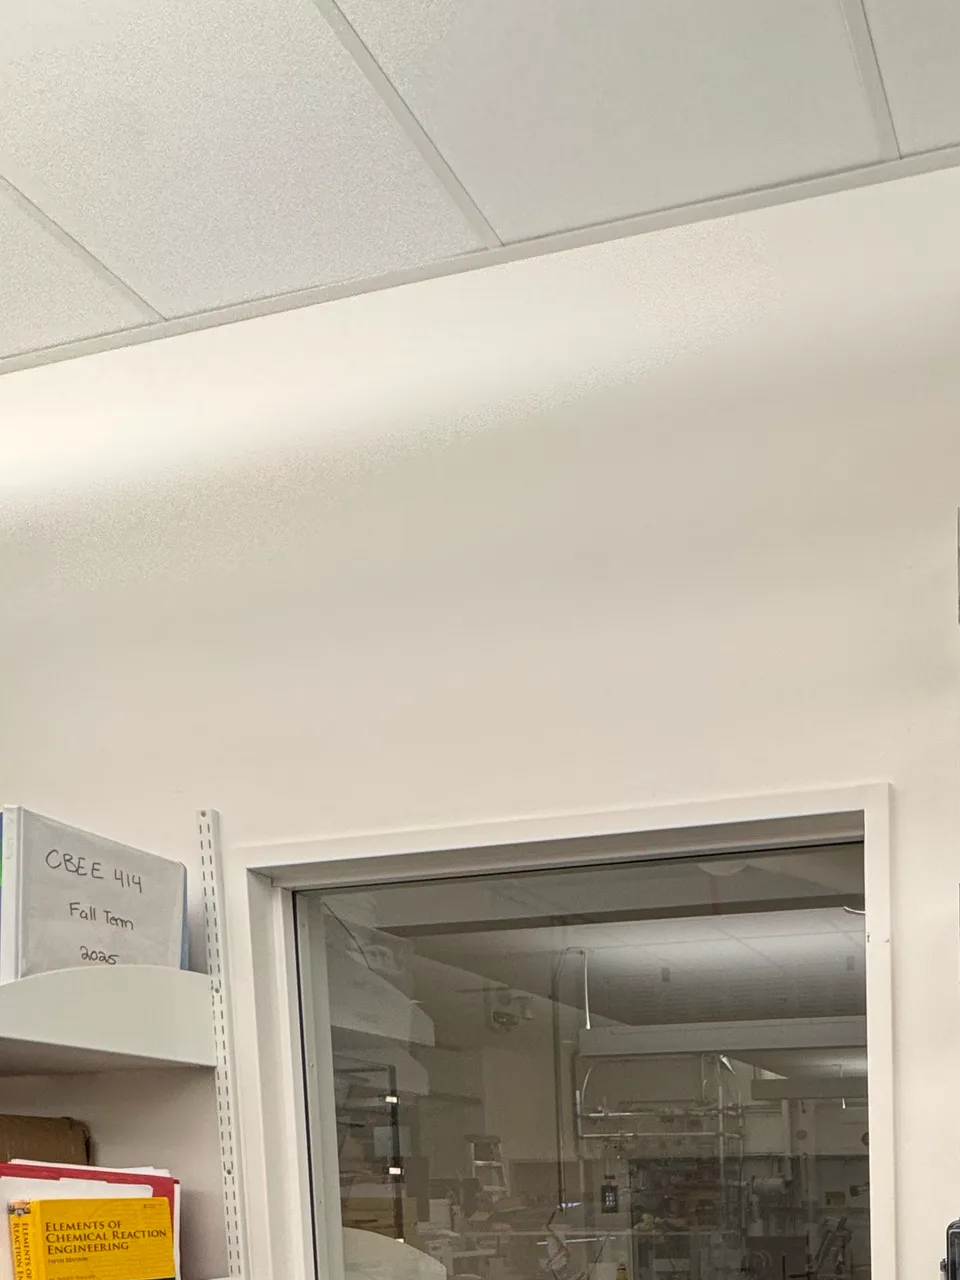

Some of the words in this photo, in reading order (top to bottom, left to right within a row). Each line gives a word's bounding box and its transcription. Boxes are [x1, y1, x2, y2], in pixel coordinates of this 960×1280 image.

[46, 849, 104, 880] CBEE
[114, 868, 143, 894] 414
[69, 902, 97, 921] Fall
[103, 910, 134, 931] Term
[79, 946, 120, 966] 2025
[45, 1221, 105, 1232] ELEMENTS
[108, 1220, 122, 1230] OF
[45, 1232, 110, 1243] CHEMICAL
[112, 1229, 167, 1240] REACTION
[13, 1223, 22, 1267] REACTION
[22, 1223, 32, 1266] ELEMENTS
[47, 1242, 129, 1255] ENGINEERING
[26, 1268, 33, 1280] OF
